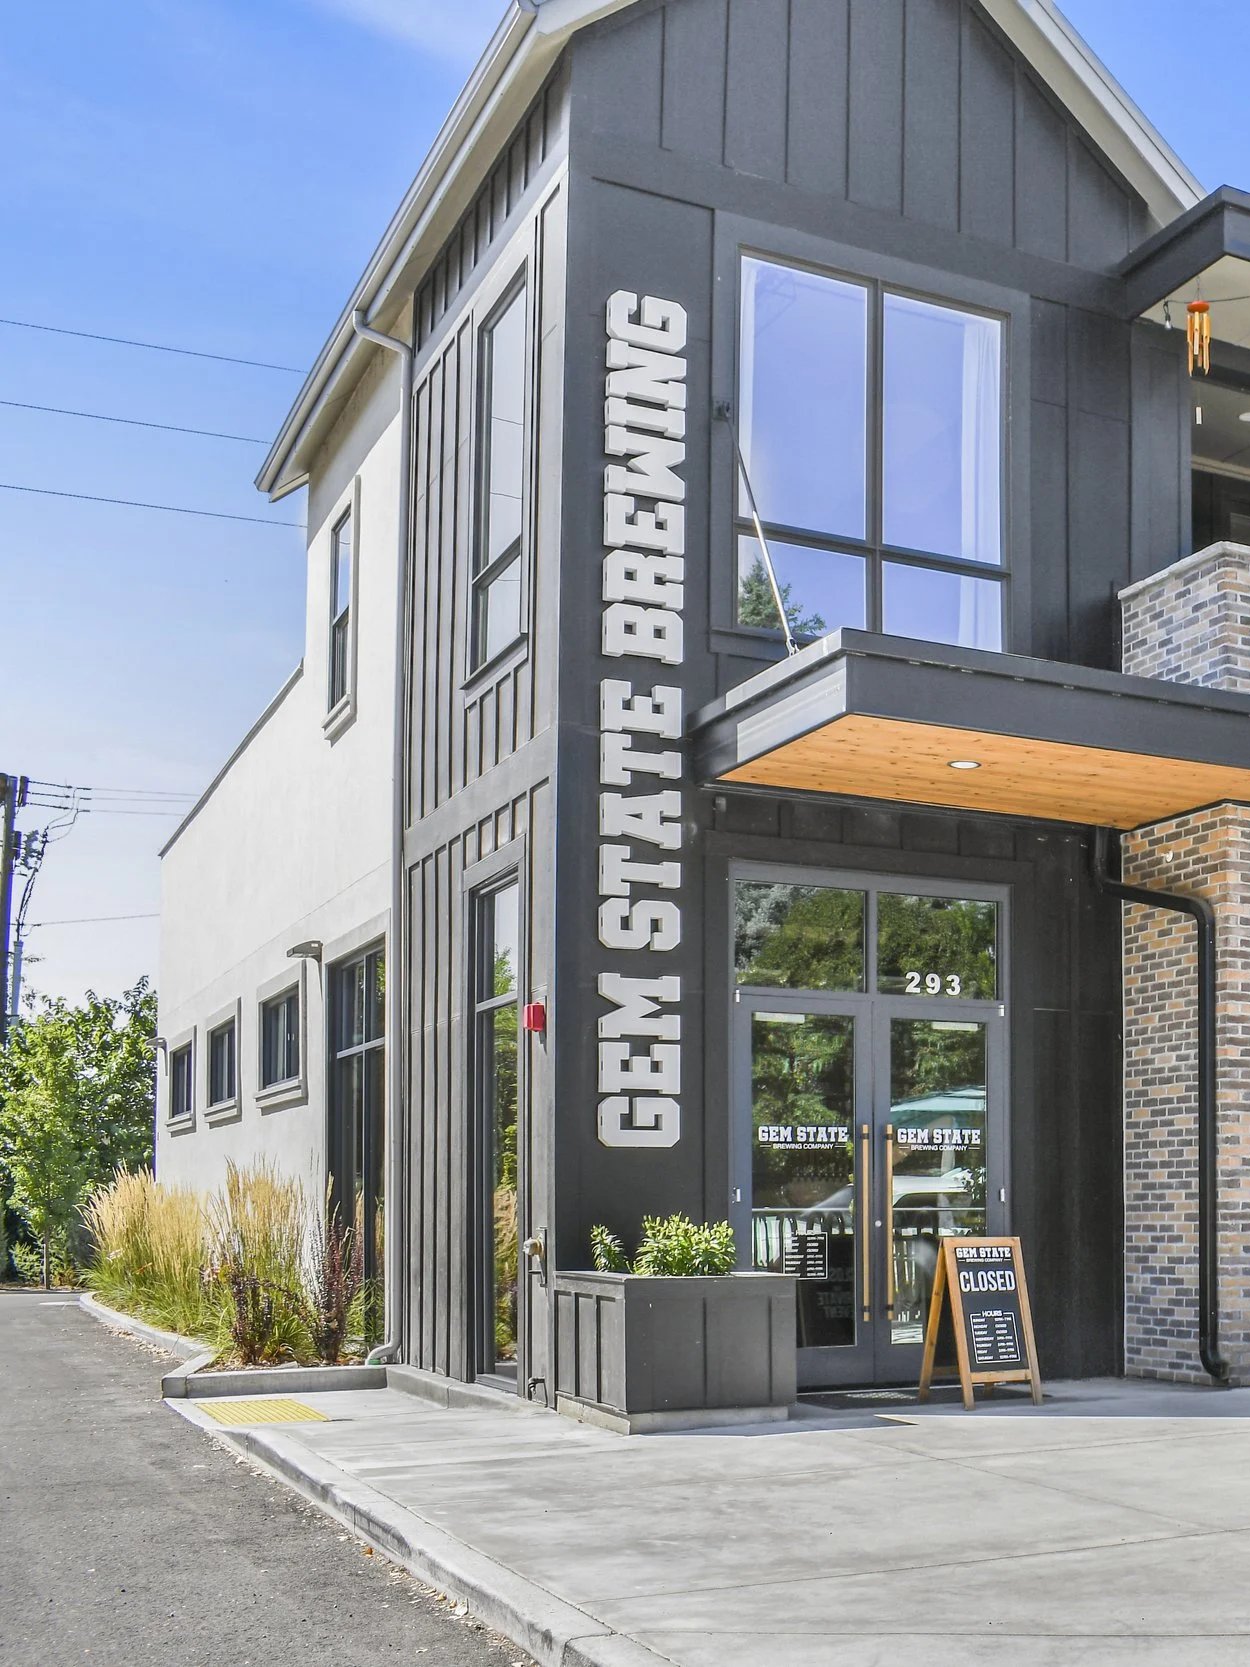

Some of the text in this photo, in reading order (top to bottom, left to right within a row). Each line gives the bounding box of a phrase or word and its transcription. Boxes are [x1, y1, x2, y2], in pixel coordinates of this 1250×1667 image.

[598, 289, 687, 1148] GEM STATE BREWING
[905, 971, 961, 996] 293
[758, 1126, 847, 1142] GEM STATE
[897, 1128, 981, 1144] GEM STATE
[956, 1247, 1011, 1258] GEM STATE
[959, 1270, 1016, 1292] CLOSED
[981, 1309, 1002, 1317] HOURS
